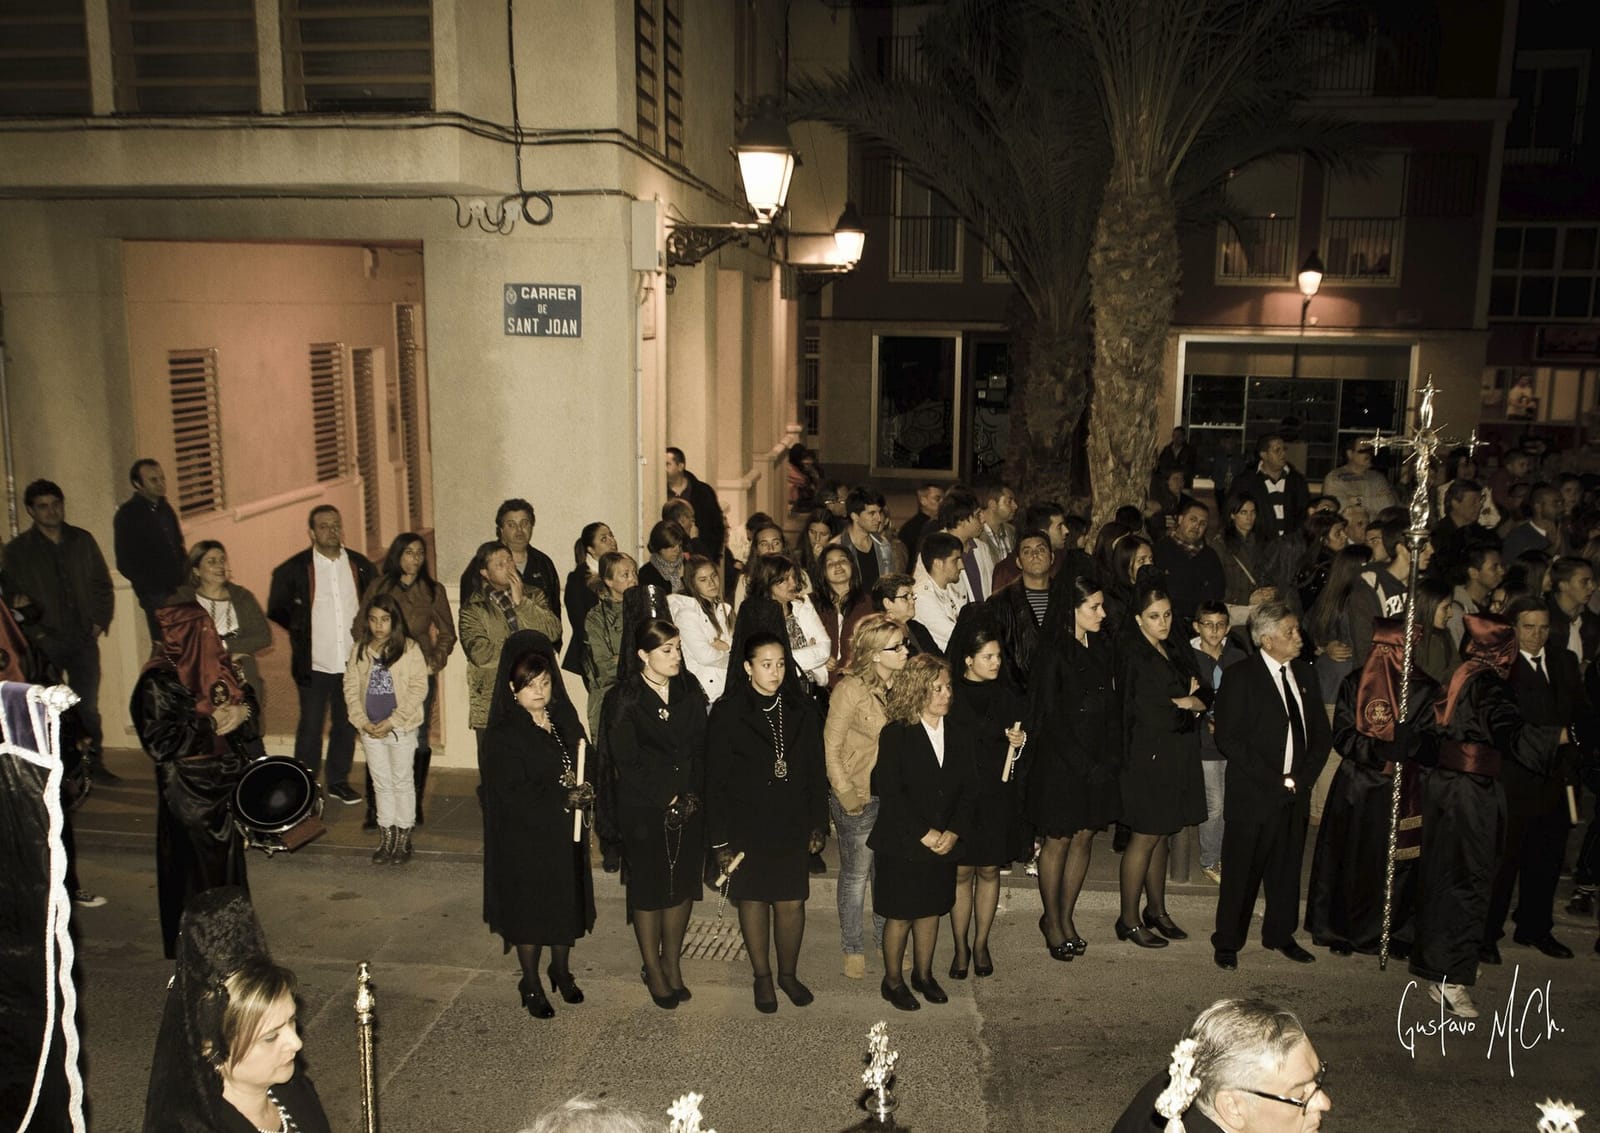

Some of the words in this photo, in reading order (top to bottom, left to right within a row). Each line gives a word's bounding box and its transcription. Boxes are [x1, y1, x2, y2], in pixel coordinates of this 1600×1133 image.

[521, 286, 577, 301] CARRER
[537, 303, 548, 315] DE
[507, 317, 539, 334] SANT
[545, 318, 577, 336] JOAN
